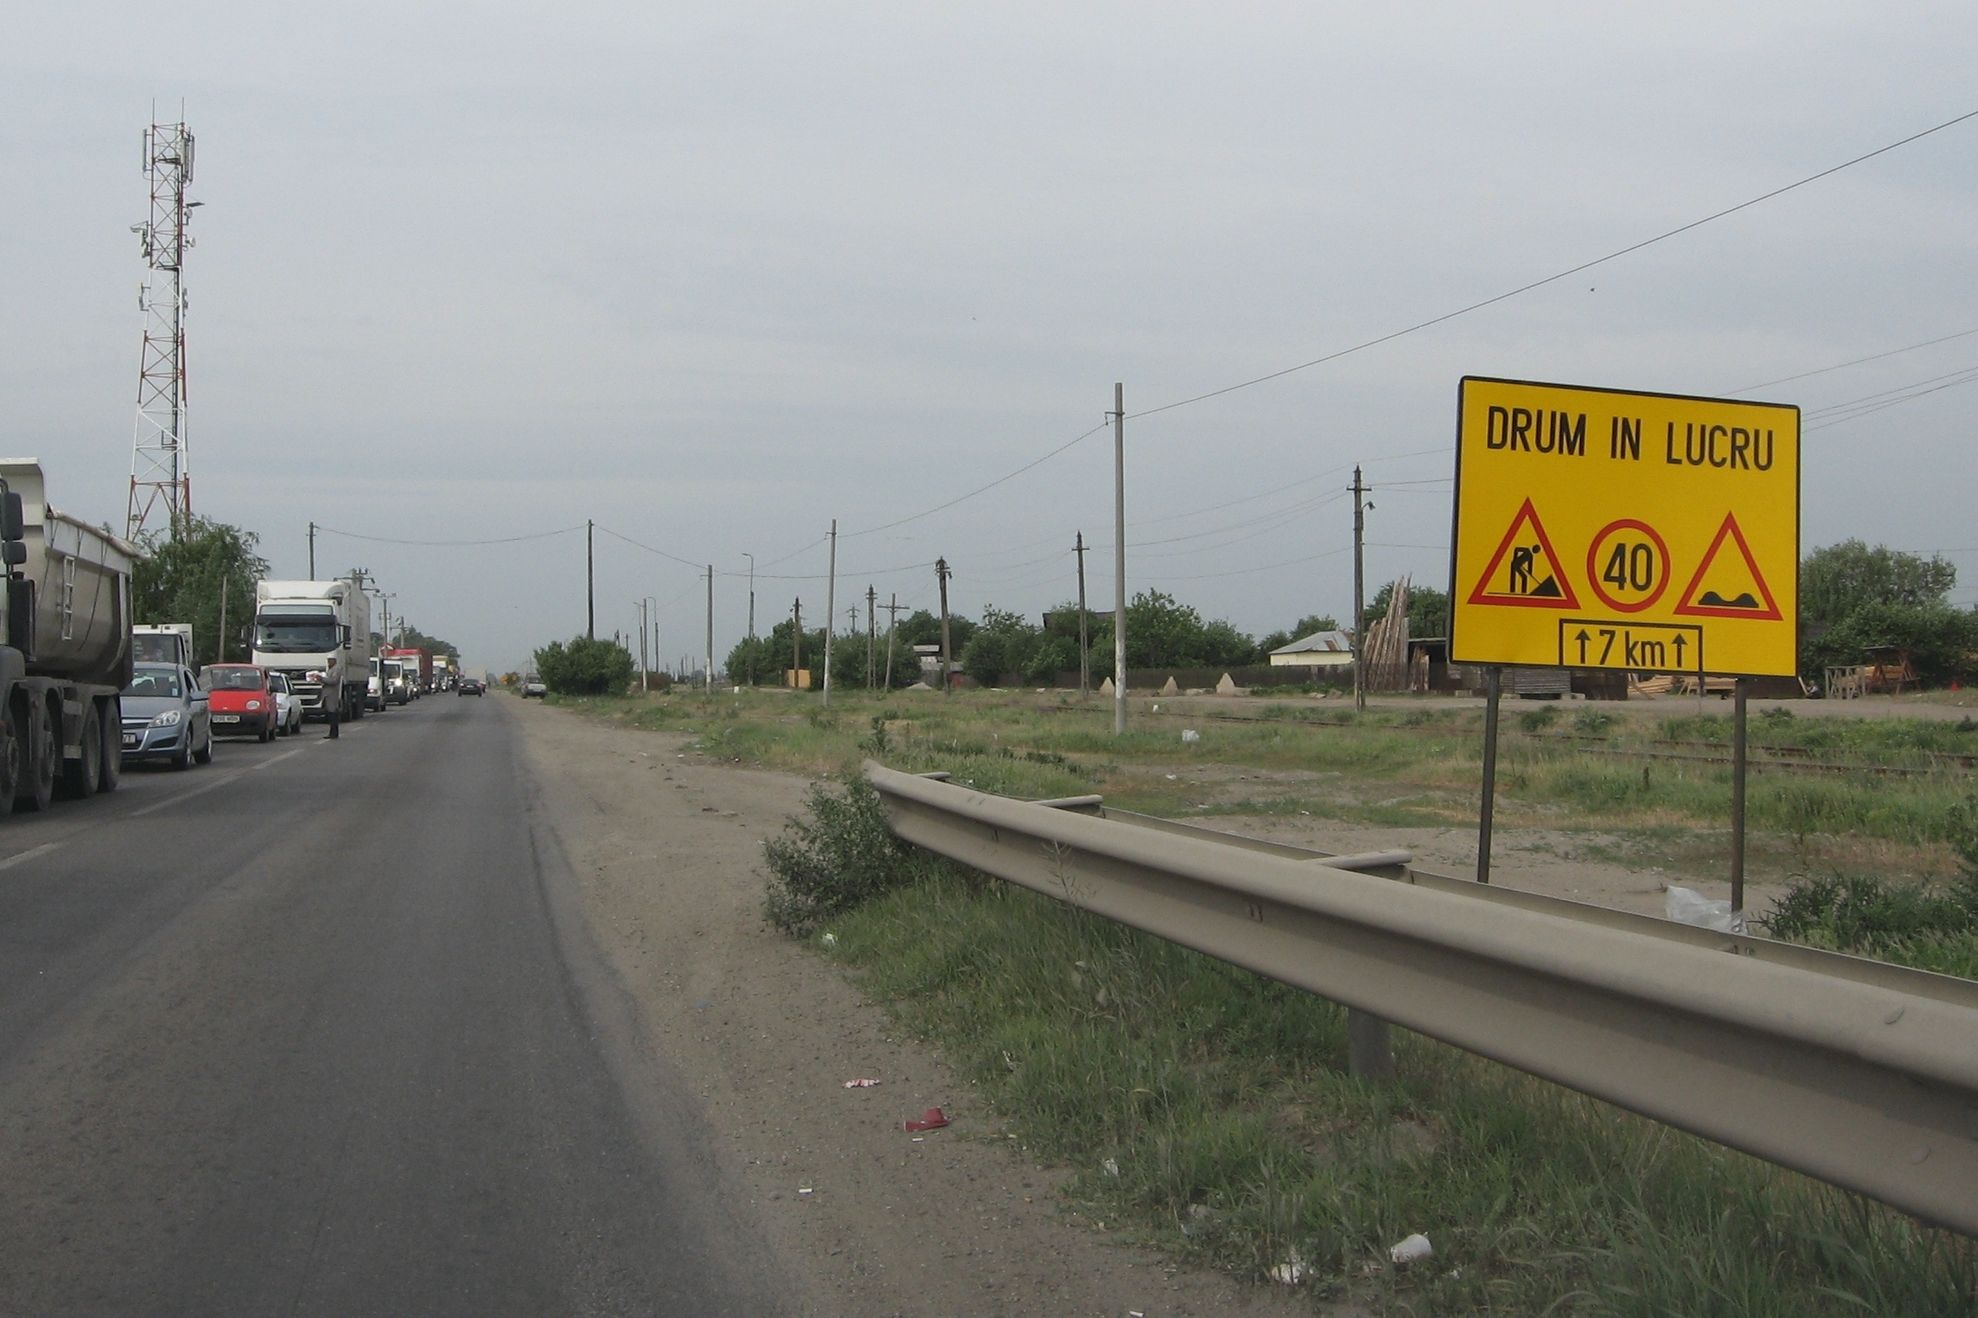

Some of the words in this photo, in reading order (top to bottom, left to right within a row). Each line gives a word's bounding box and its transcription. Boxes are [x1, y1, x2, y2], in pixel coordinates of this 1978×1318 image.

[1487, 406, 1586, 456] DRUM
[1610, 416, 1641, 460] IN
[1666, 422, 1773, 471] LUCRU
[1603, 543, 1653, 591] 40
[1599, 630, 1616, 665] 7
[1625, 631, 1665, 667] km
